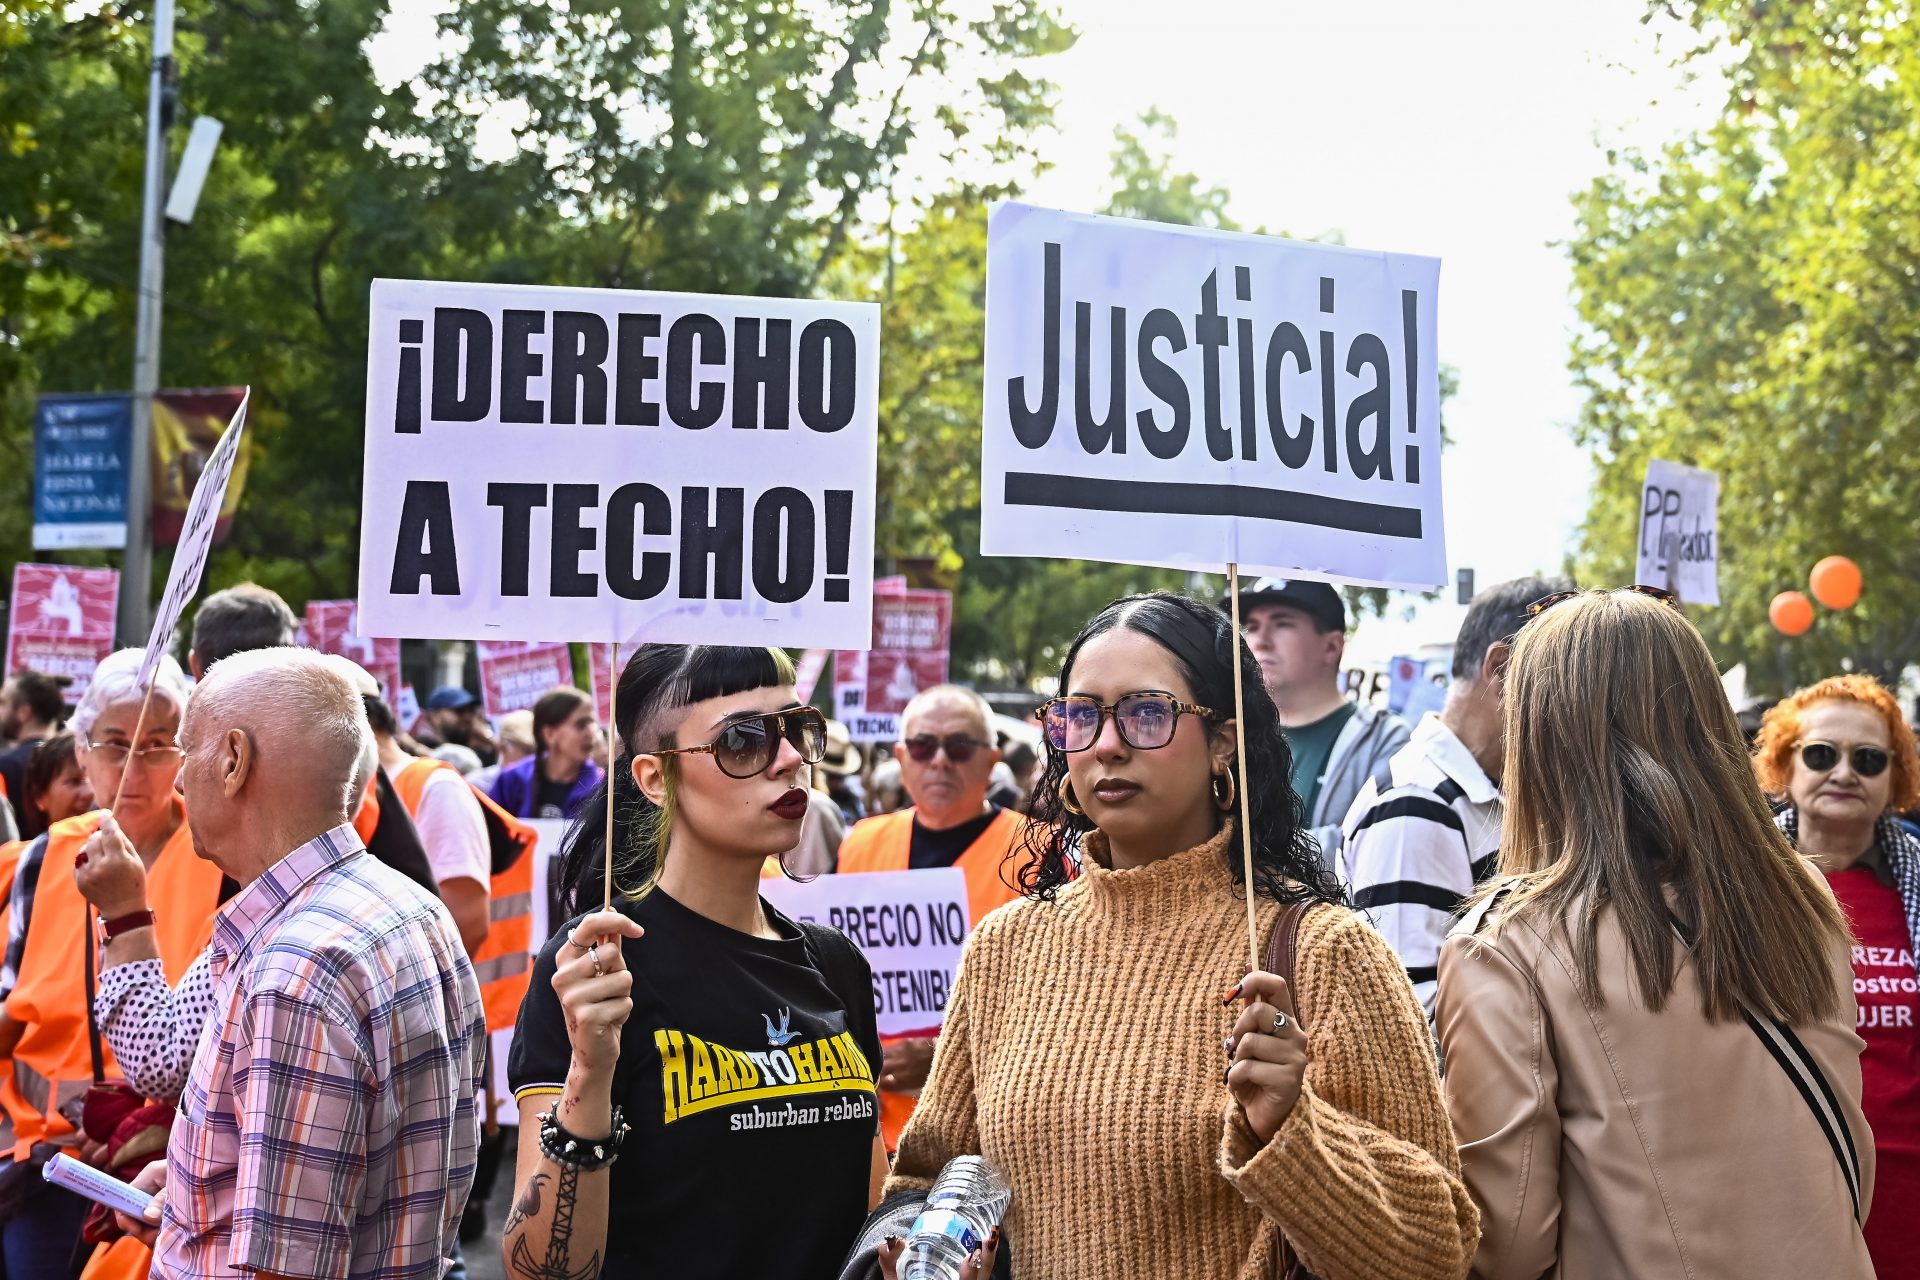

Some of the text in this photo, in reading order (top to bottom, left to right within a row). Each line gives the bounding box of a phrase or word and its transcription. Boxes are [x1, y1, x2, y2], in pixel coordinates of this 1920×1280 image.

[395, 307, 856, 434] ¡DERECHO
[1008, 242, 1420, 484] Justicia!
[389, 481, 854, 604] A TECHO!
[927, 901, 965, 947] NO
[1854, 975, 1920, 994] ostro
[730, 1094, 873, 1131] suburban rebels
